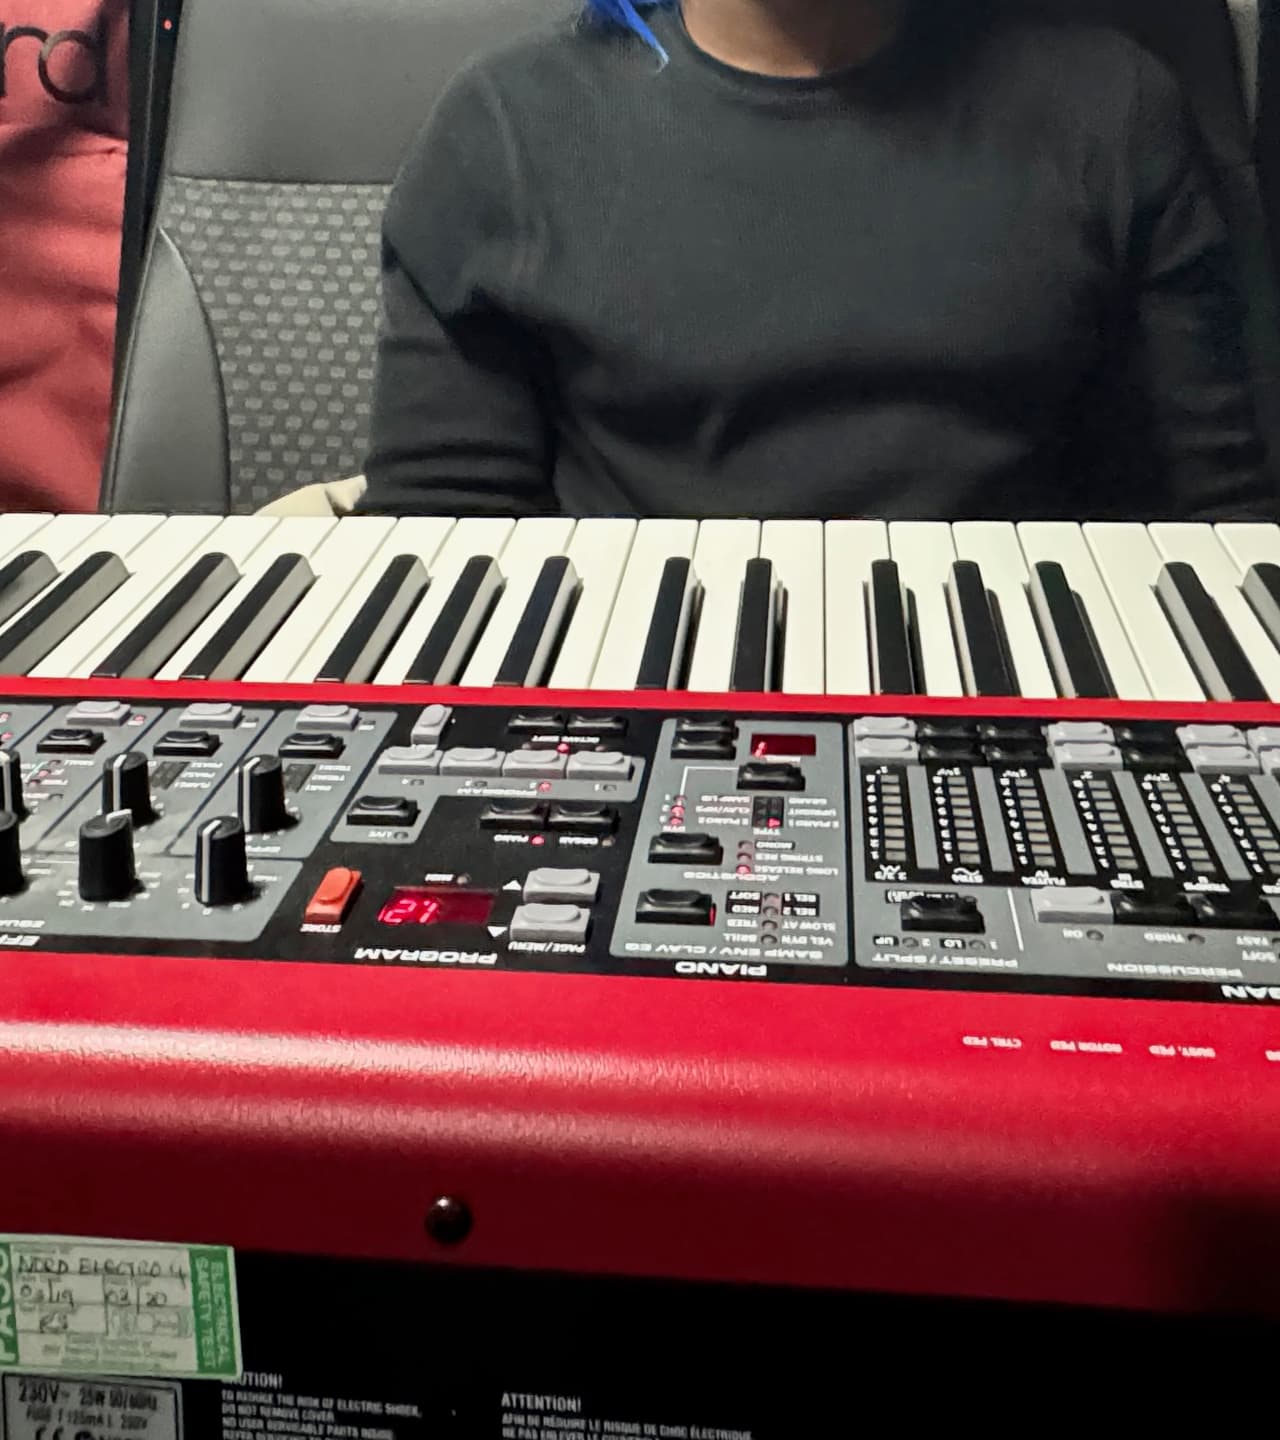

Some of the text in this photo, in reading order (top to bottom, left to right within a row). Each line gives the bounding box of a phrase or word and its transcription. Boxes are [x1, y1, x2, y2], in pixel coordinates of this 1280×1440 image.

[780, 853, 824, 863] STRING
[753, 864, 839, 876] LONG RELEASE
[683, 871, 780, 883] ACOUSTICS
[729, 890, 760, 900] SOFT
[731, 904, 760, 914] MED
[300, 923, 342, 933] STORE
[781, 920, 836, 932] SLOW AT
[722, 932, 758, 943] BRILL
[781, 935, 834, 947] VEL DYN
[874, 936, 895, 946] UP
[507, 940, 586, 953] PAGE/MENU
[654, 943, 707, 954] CLAV
[718, 946, 761, 958] ENV
[354, 948, 498, 965] PROGRAM
[763, 948, 823, 960] SAMP
[871, 953, 1018, 969] PRESET SPLIT
[674, 961, 768, 977] PIANO
[1106, 962, 1243, 979] PERCUSSION
[196, 1256, 216, 1368] SAFETY TEST
[228, 1370, 283, 1390] UTION!
[500, 1391, 582, 1413] ATTENTION!
